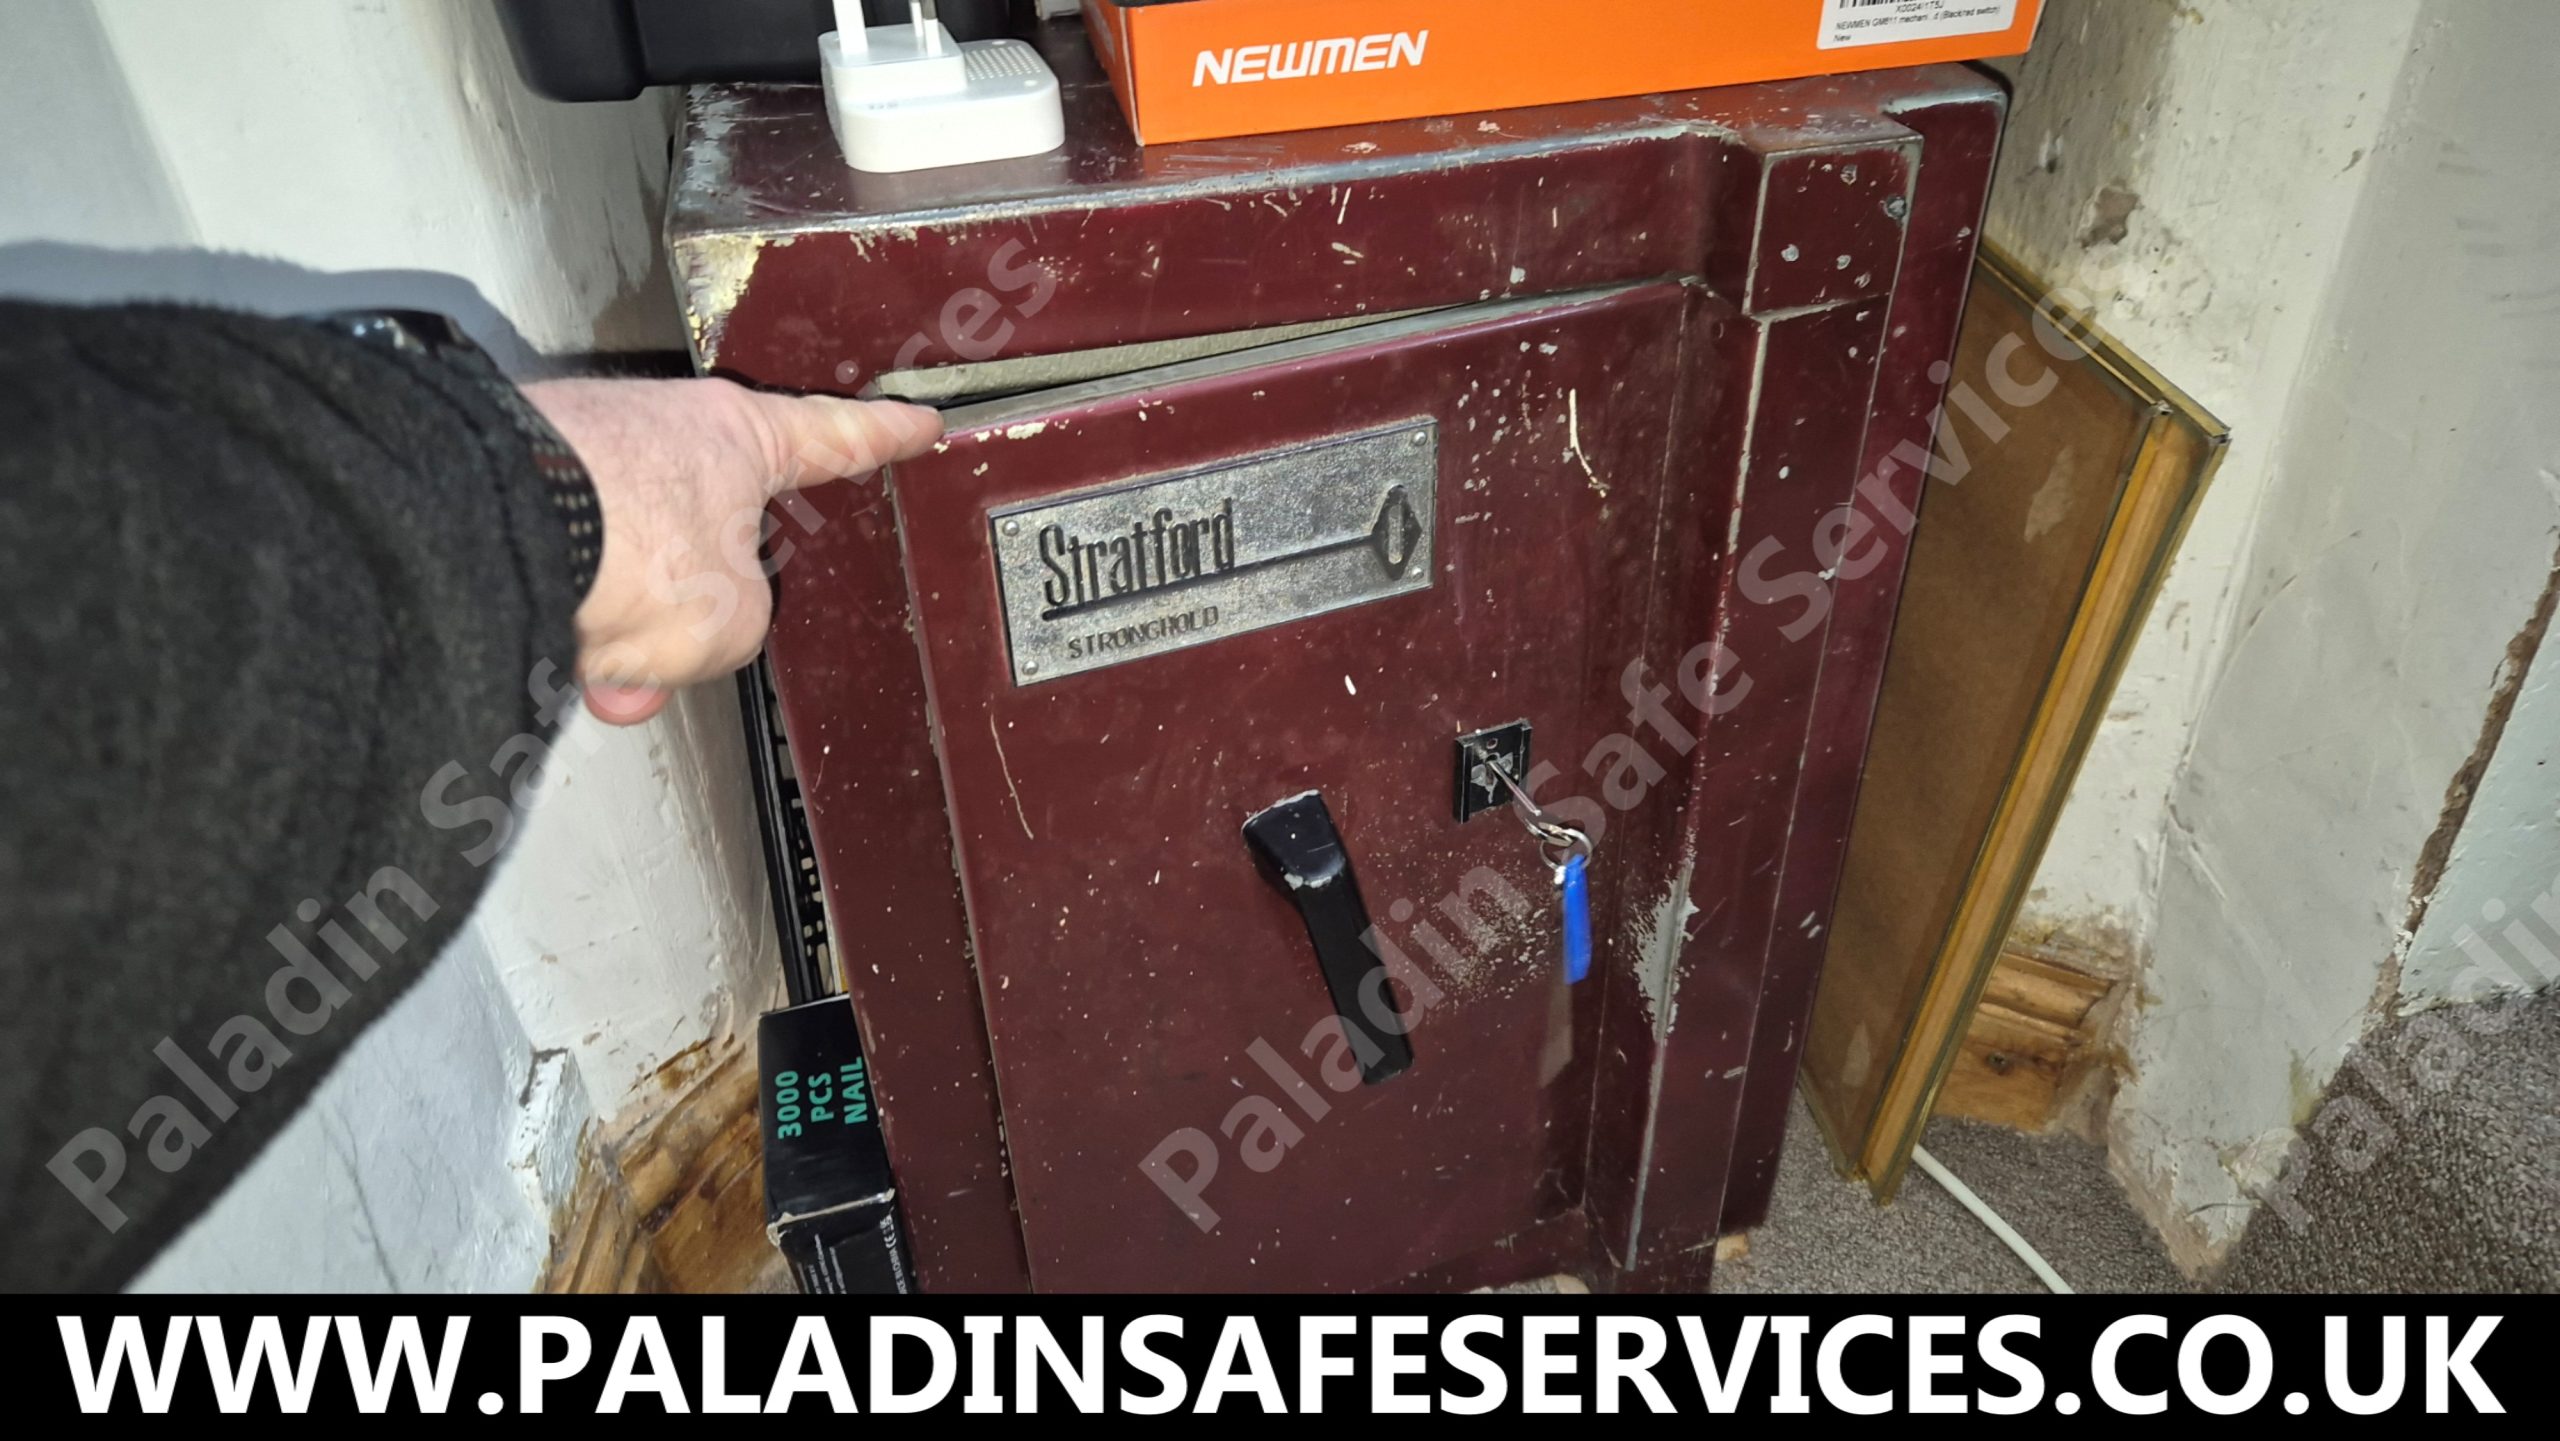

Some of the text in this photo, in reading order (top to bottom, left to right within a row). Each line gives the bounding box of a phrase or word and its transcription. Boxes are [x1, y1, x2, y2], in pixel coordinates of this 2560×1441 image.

[1833, 33, 1852, 42] New
[1835, 20, 1871, 30] NEWMEN
[1192, 30, 1428, 87] NEWMEN
[1039, 497, 1235, 606] Stratford
[1068, 605, 1220, 660] STRONGHOLD
[775, 1070, 802, 1139] 3000
[808, 1072, 834, 1123] PCS
[840, 1056, 868, 1124] NAIL
